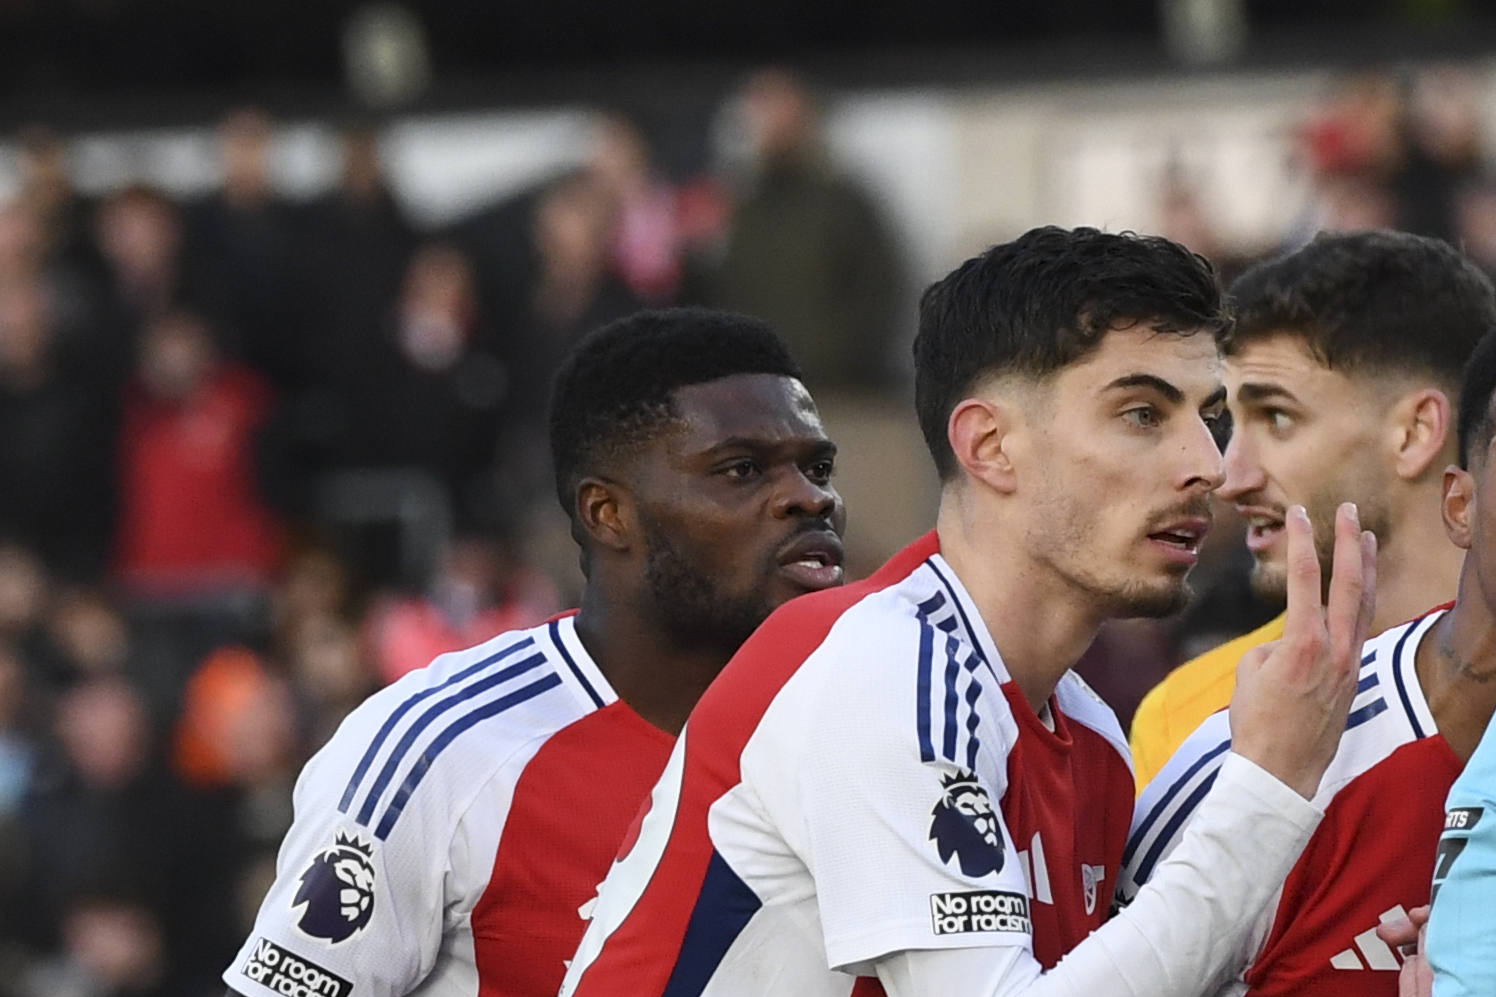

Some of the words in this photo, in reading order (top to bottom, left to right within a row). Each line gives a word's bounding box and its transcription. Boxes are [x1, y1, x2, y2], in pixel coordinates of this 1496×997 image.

[931, 893, 967, 915] No
[971, 894, 1025, 914] room
[934, 913, 968, 934] for
[971, 914, 1031, 934] racism
[249, 938, 280, 967] No
[242, 953, 273, 983] for
